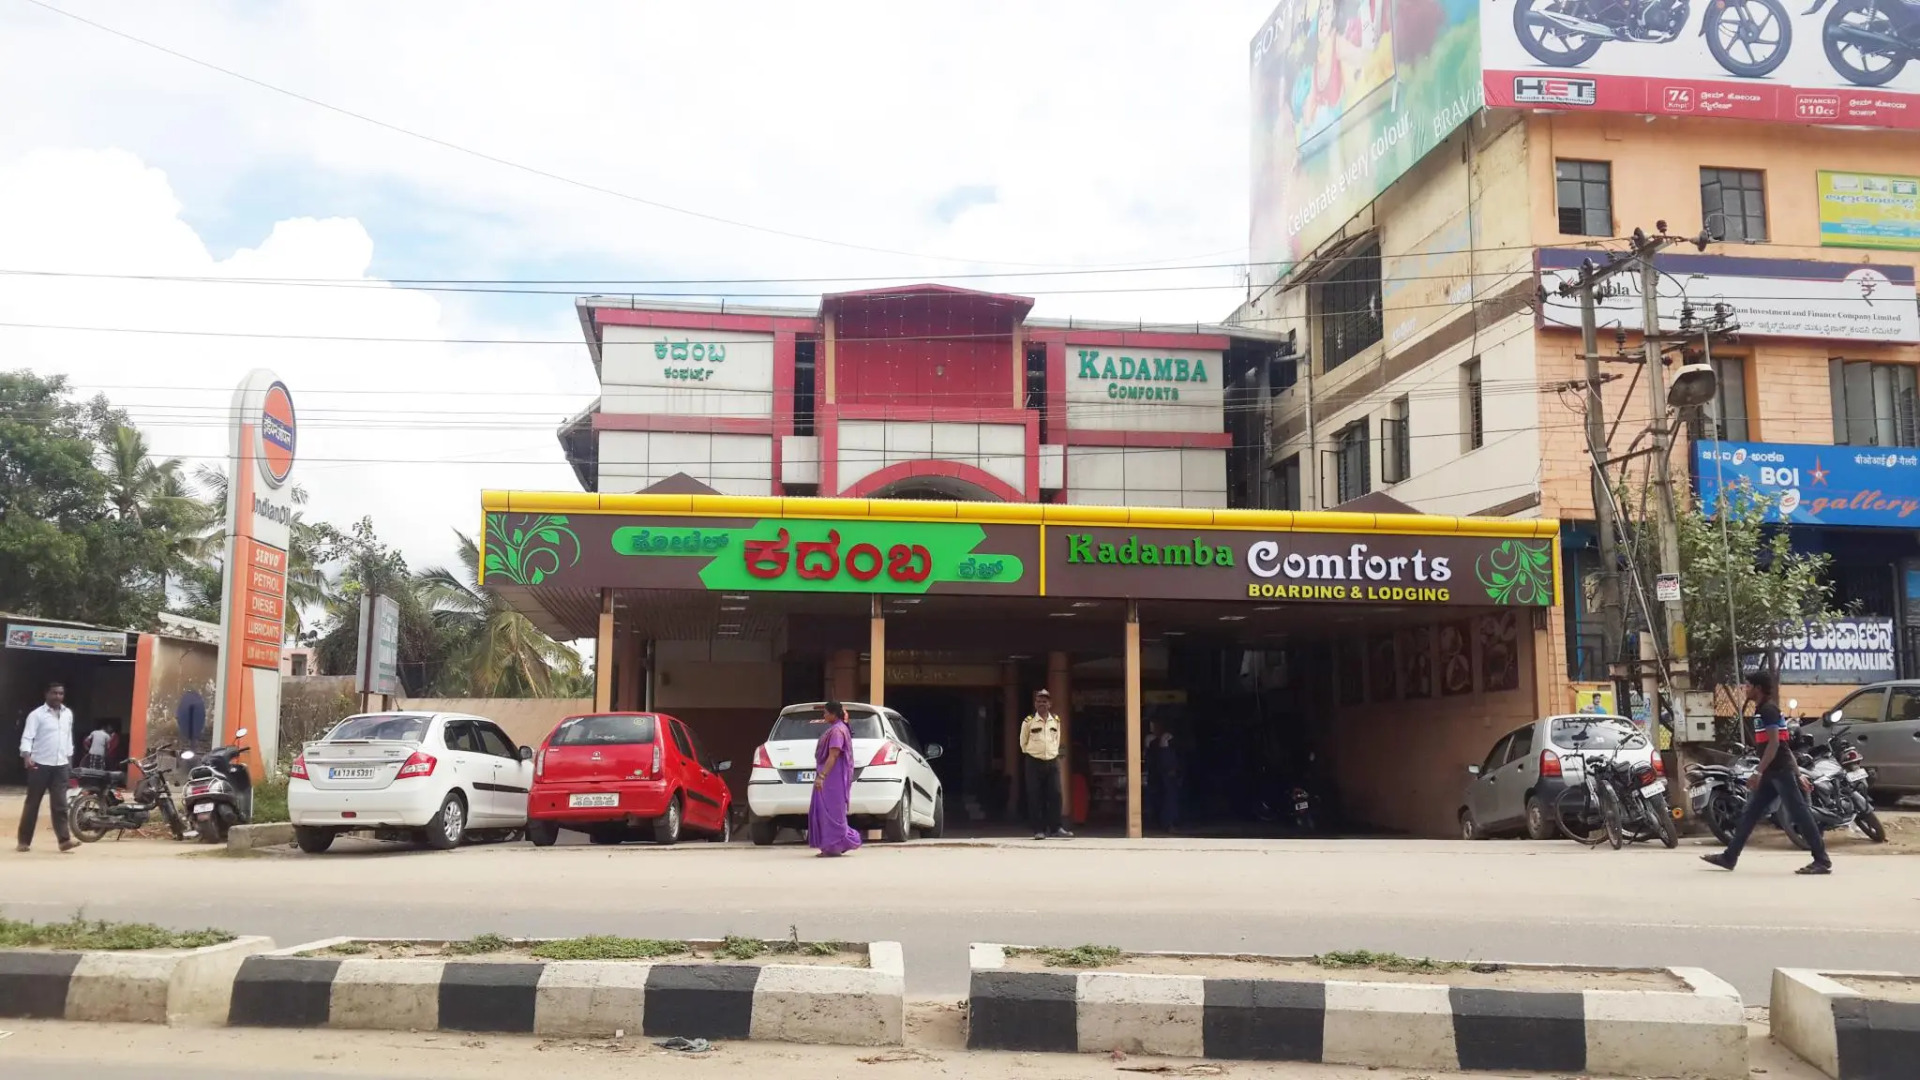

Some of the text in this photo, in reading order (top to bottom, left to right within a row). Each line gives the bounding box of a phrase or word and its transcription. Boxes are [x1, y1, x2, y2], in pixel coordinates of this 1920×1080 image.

[1669, 90, 1689, 102] 74
[1433, 80, 1486, 139] BRAVIA
[1800, 105, 1835, 116] 110cc
[1288, 184, 1337, 237] Celebrate
[1337, 153, 1369, 194] every
[1750, 307, 1790, 317] Investment
[1792, 309, 1807, 317] and
[1807, 310, 1837, 318] Finance
[1838, 312, 1871, 321] Company
[1873, 313, 1902, 321] Limited
[654, 336, 726, 362] ಕದಂಬ
[1078, 350, 1208, 382] KADAMBA
[1761, 466, 1800, 487] BOI
[252, 492, 291, 526] IndianOil
[255, 548, 279, 567] SERVO
[744, 527, 932, 582] ಕದಂಬ
[1066, 533, 1453, 582] Kadamba Comforts
[253, 571, 281, 591] PETROL
[1248, 583, 1451, 602] BOARDING & LODGING
[252, 597, 279, 615] DIESEL
[247, 619, 280, 639] LUBRICANTS
[1818, 652, 1895, 671] TARPAULINS
